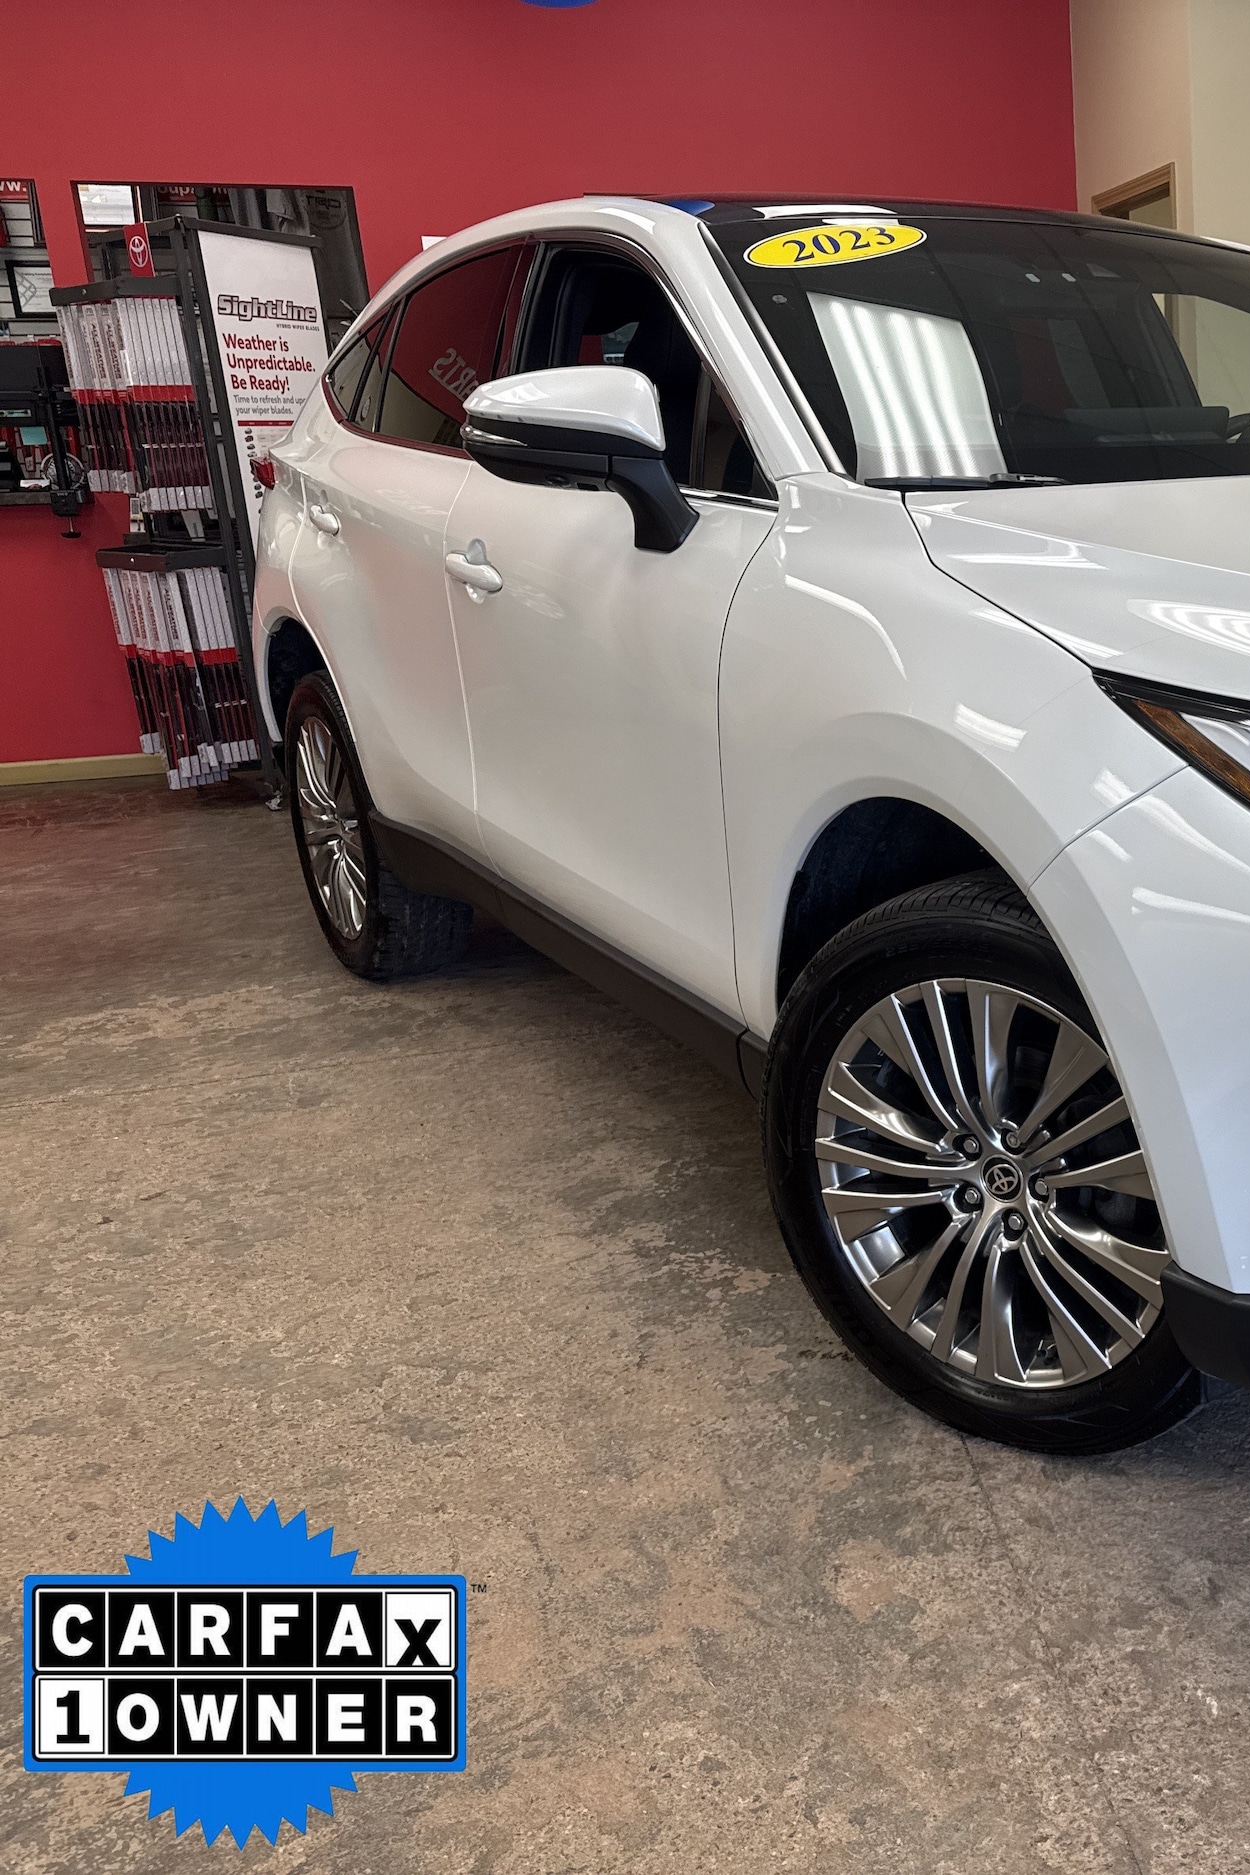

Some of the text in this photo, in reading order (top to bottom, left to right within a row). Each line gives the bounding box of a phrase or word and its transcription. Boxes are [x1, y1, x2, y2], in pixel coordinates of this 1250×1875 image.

[782, 226, 896, 263] 2023
[217, 294, 317, 322] SightLine
[222, 333, 289, 352] Weather is
[226, 353, 316, 374] Unpredictable.
[230, 374, 290, 394] Be Ready!
[233, 395, 250, 404] Time
[253, 396, 259, 404] to
[260, 395, 282, 405] refresh
[283, 396, 294, 405] and
[235, 406, 293, 416] your wiper blades.
